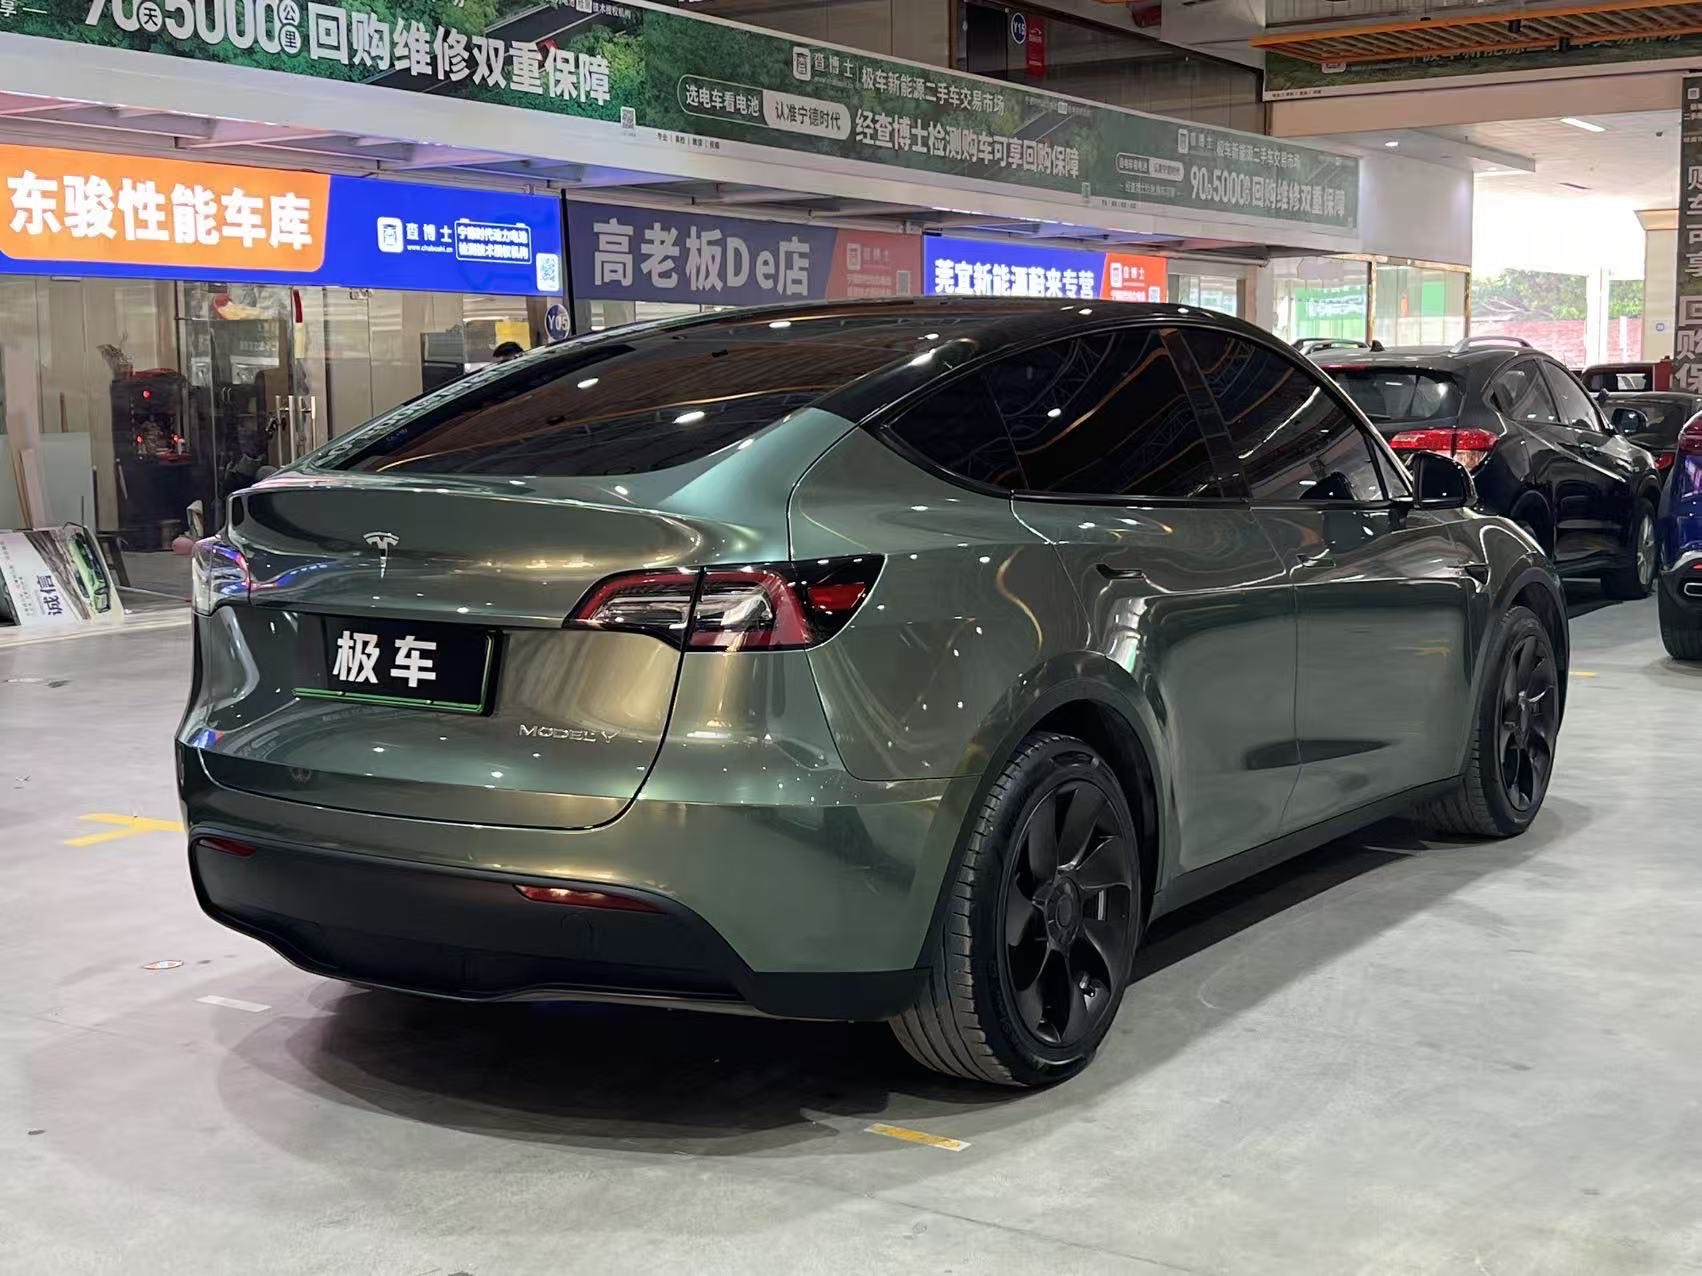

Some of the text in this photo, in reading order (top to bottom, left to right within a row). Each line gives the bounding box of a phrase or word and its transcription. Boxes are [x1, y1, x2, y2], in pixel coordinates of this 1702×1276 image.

[685, 84, 760, 117] 选电车看电池
[774, 101, 841, 131] 认准宁德时代
[862, 66, 1005, 116] 极车新能源二手车交易市场
[855, 109, 1080, 179] 经查博士检测购车可享回购保障
[7, 169, 313, 251] 东骏性能车库
[593, 217, 810, 297] 高老板De店
[331, 629, 438, 689] 极车
[519, 723, 619, 744] MODEL Y
